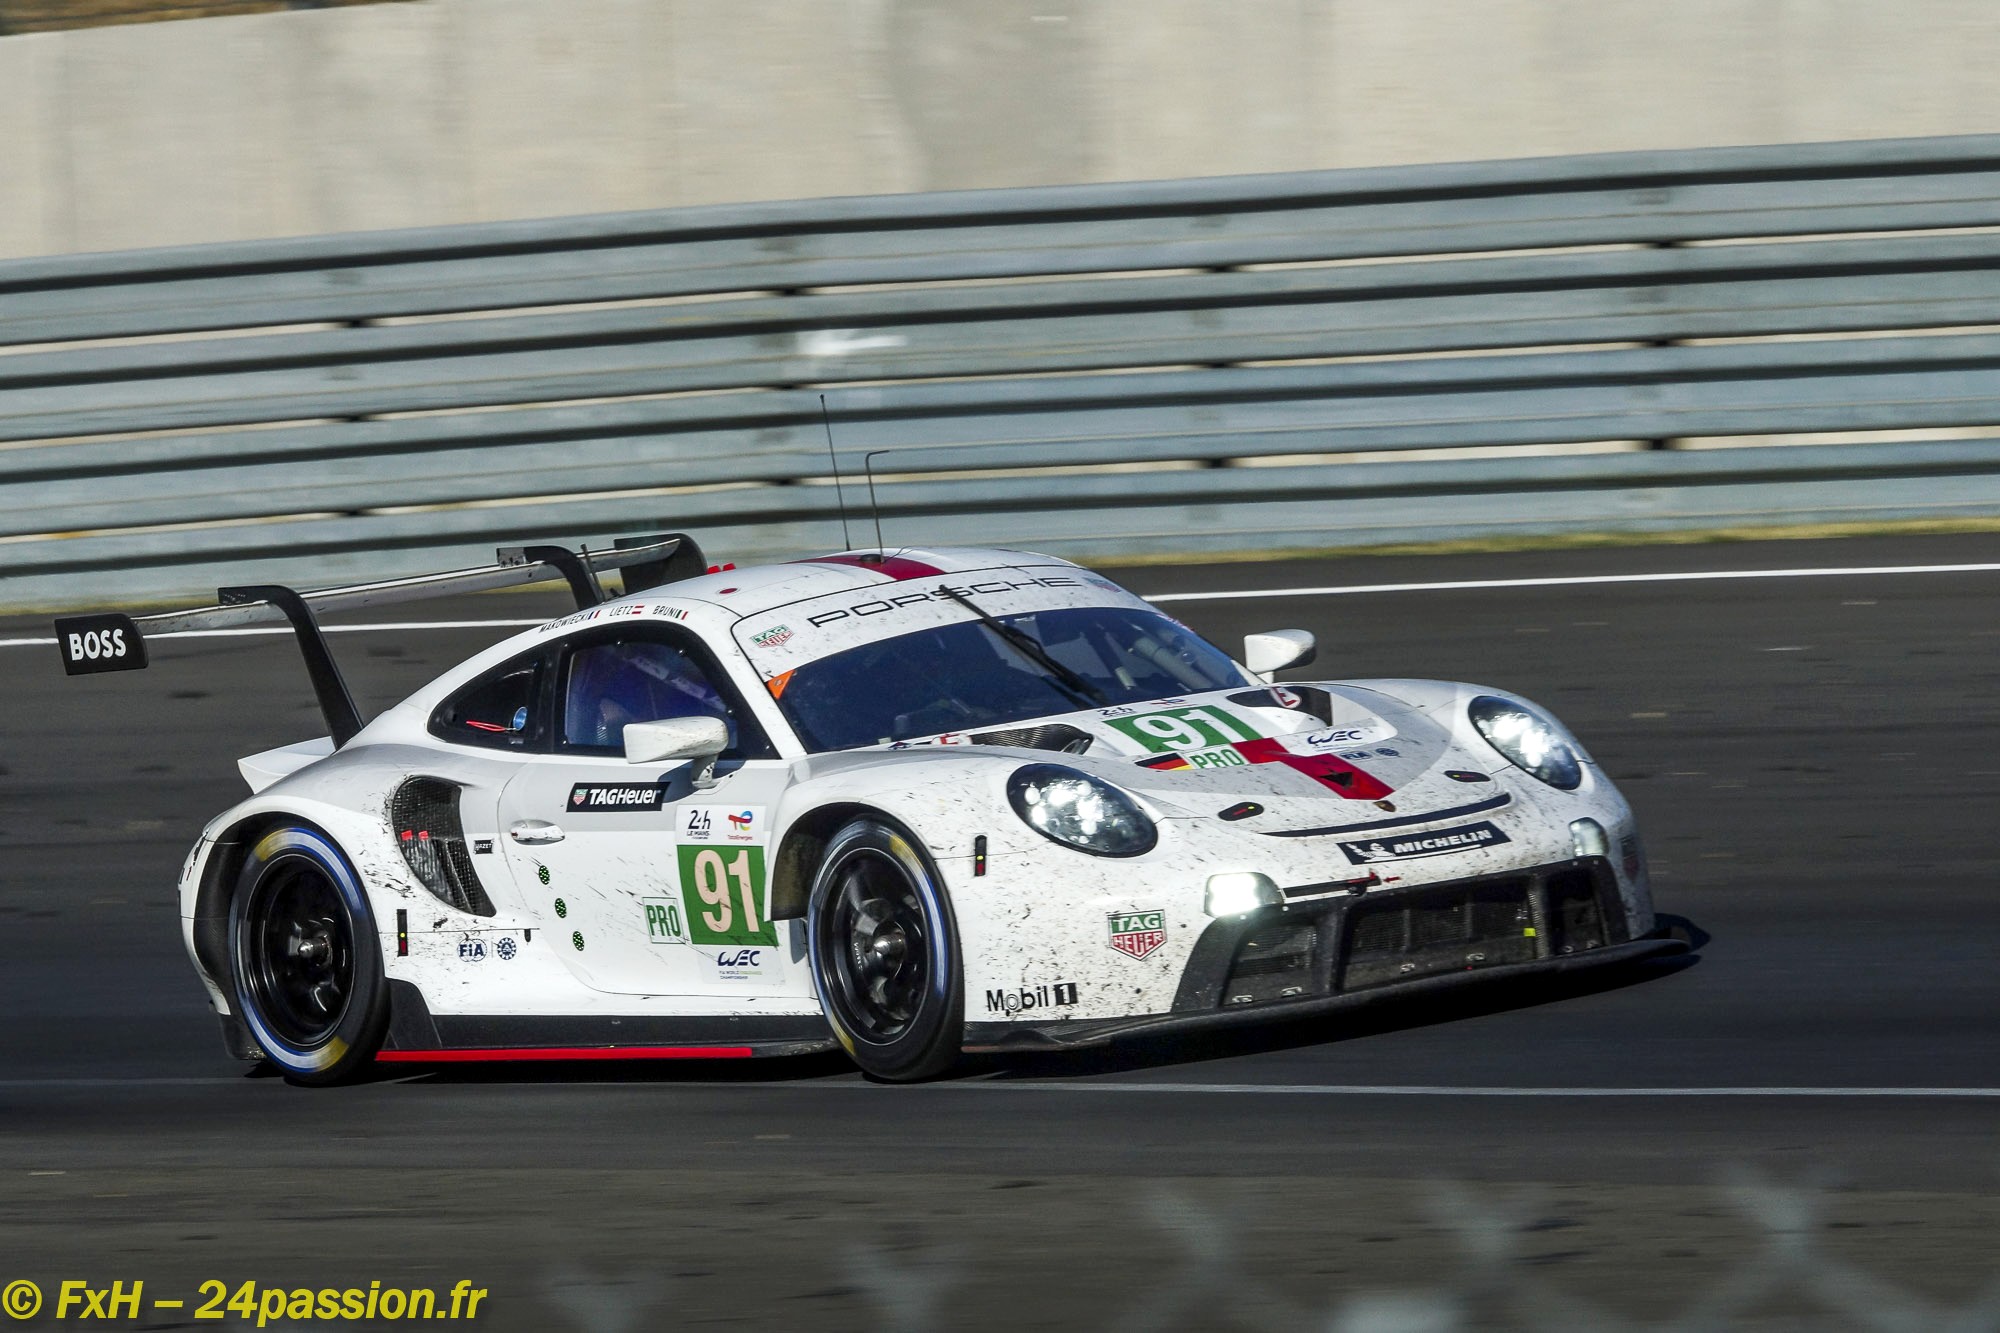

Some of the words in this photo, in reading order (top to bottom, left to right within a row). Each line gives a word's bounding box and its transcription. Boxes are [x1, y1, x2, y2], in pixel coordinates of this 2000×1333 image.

[609, 605, 634, 617] LIETZ
[652, 605, 678, 617] BRUNI
[807, 577, 1082, 627] PORSCHE
[539, 613, 590, 632] MAKOWIECKI
[68, 628, 127, 661] BOSS
[1132, 709, 1249, 751] 91
[1307, 730, 1363, 745] WEC
[1189, 749, 1245, 769] PRO
[1393, 829, 1493, 854] MICHELIN
[694, 849, 760, 933] 91
[645, 904, 682, 937] PRO
[1112, 914, 1160, 932] TAG
[1112, 932, 1163, 957] HEUER
[717, 949, 761, 967] WEC
[986, 985, 1049, 1012] Mobil
